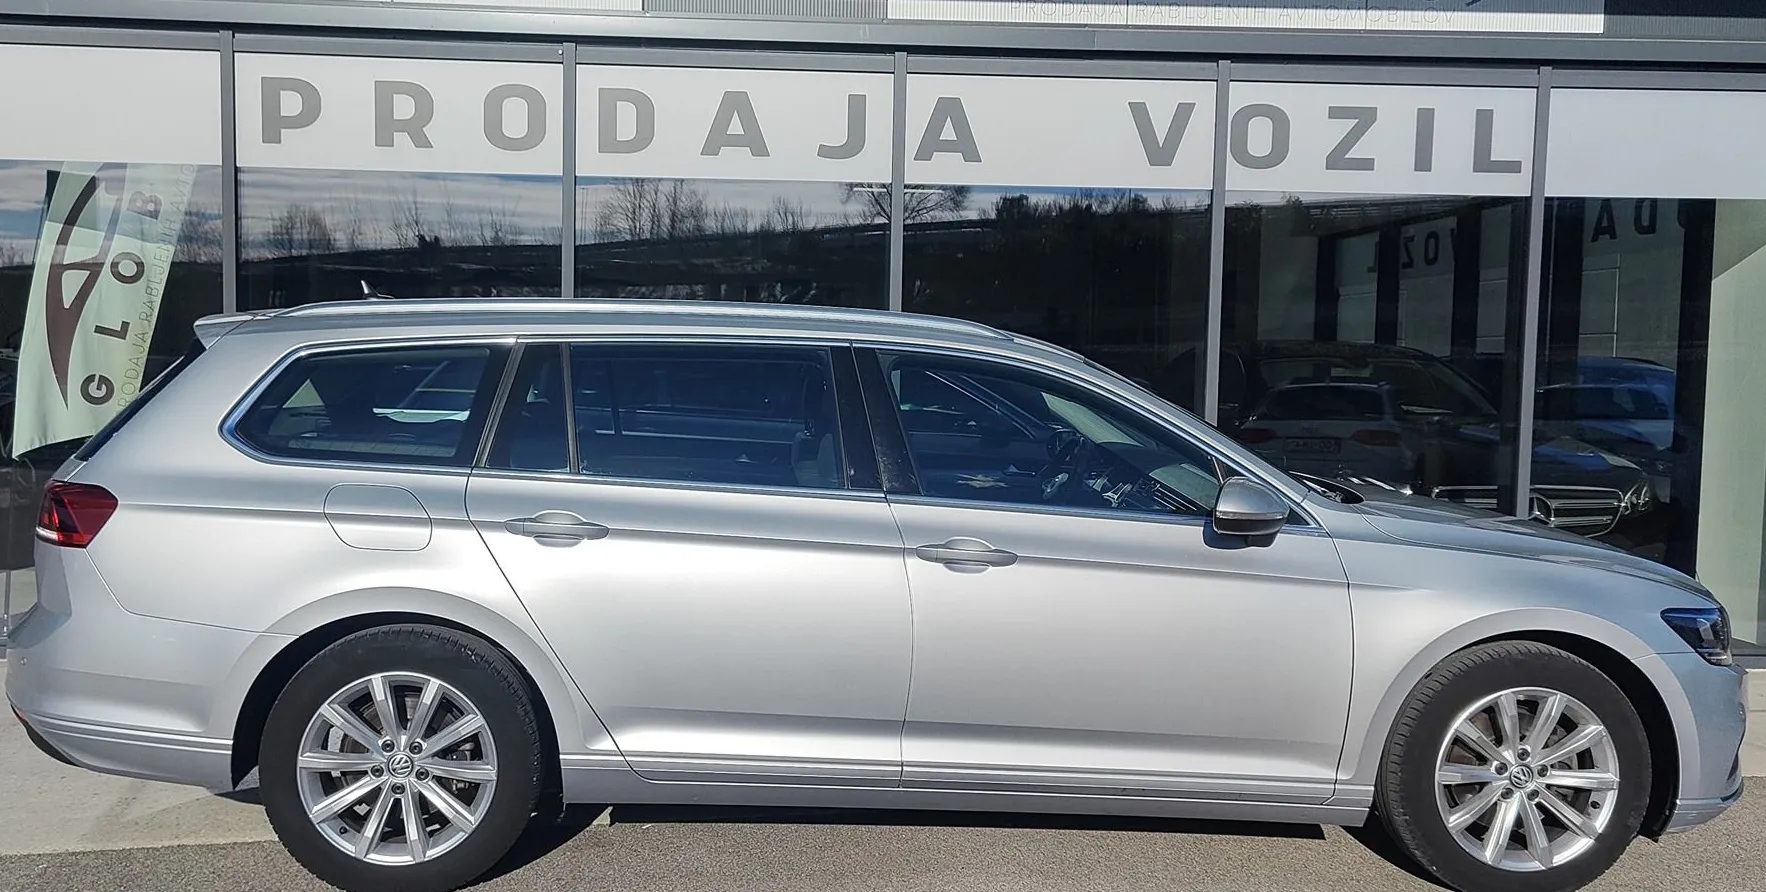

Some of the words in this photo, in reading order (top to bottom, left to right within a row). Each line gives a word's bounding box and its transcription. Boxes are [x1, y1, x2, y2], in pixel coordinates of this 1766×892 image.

[1010, 0, 1125, 17] PRODAJA
[1135, 2, 1266, 21] RABLJENIH
[1278, 4, 1456, 24] AVTOMOBILOV
[261, 76, 982, 163] PRODAJA
[1128, 101, 1523, 174] VOZIL
[115, 330, 150, 410] RODAJA
